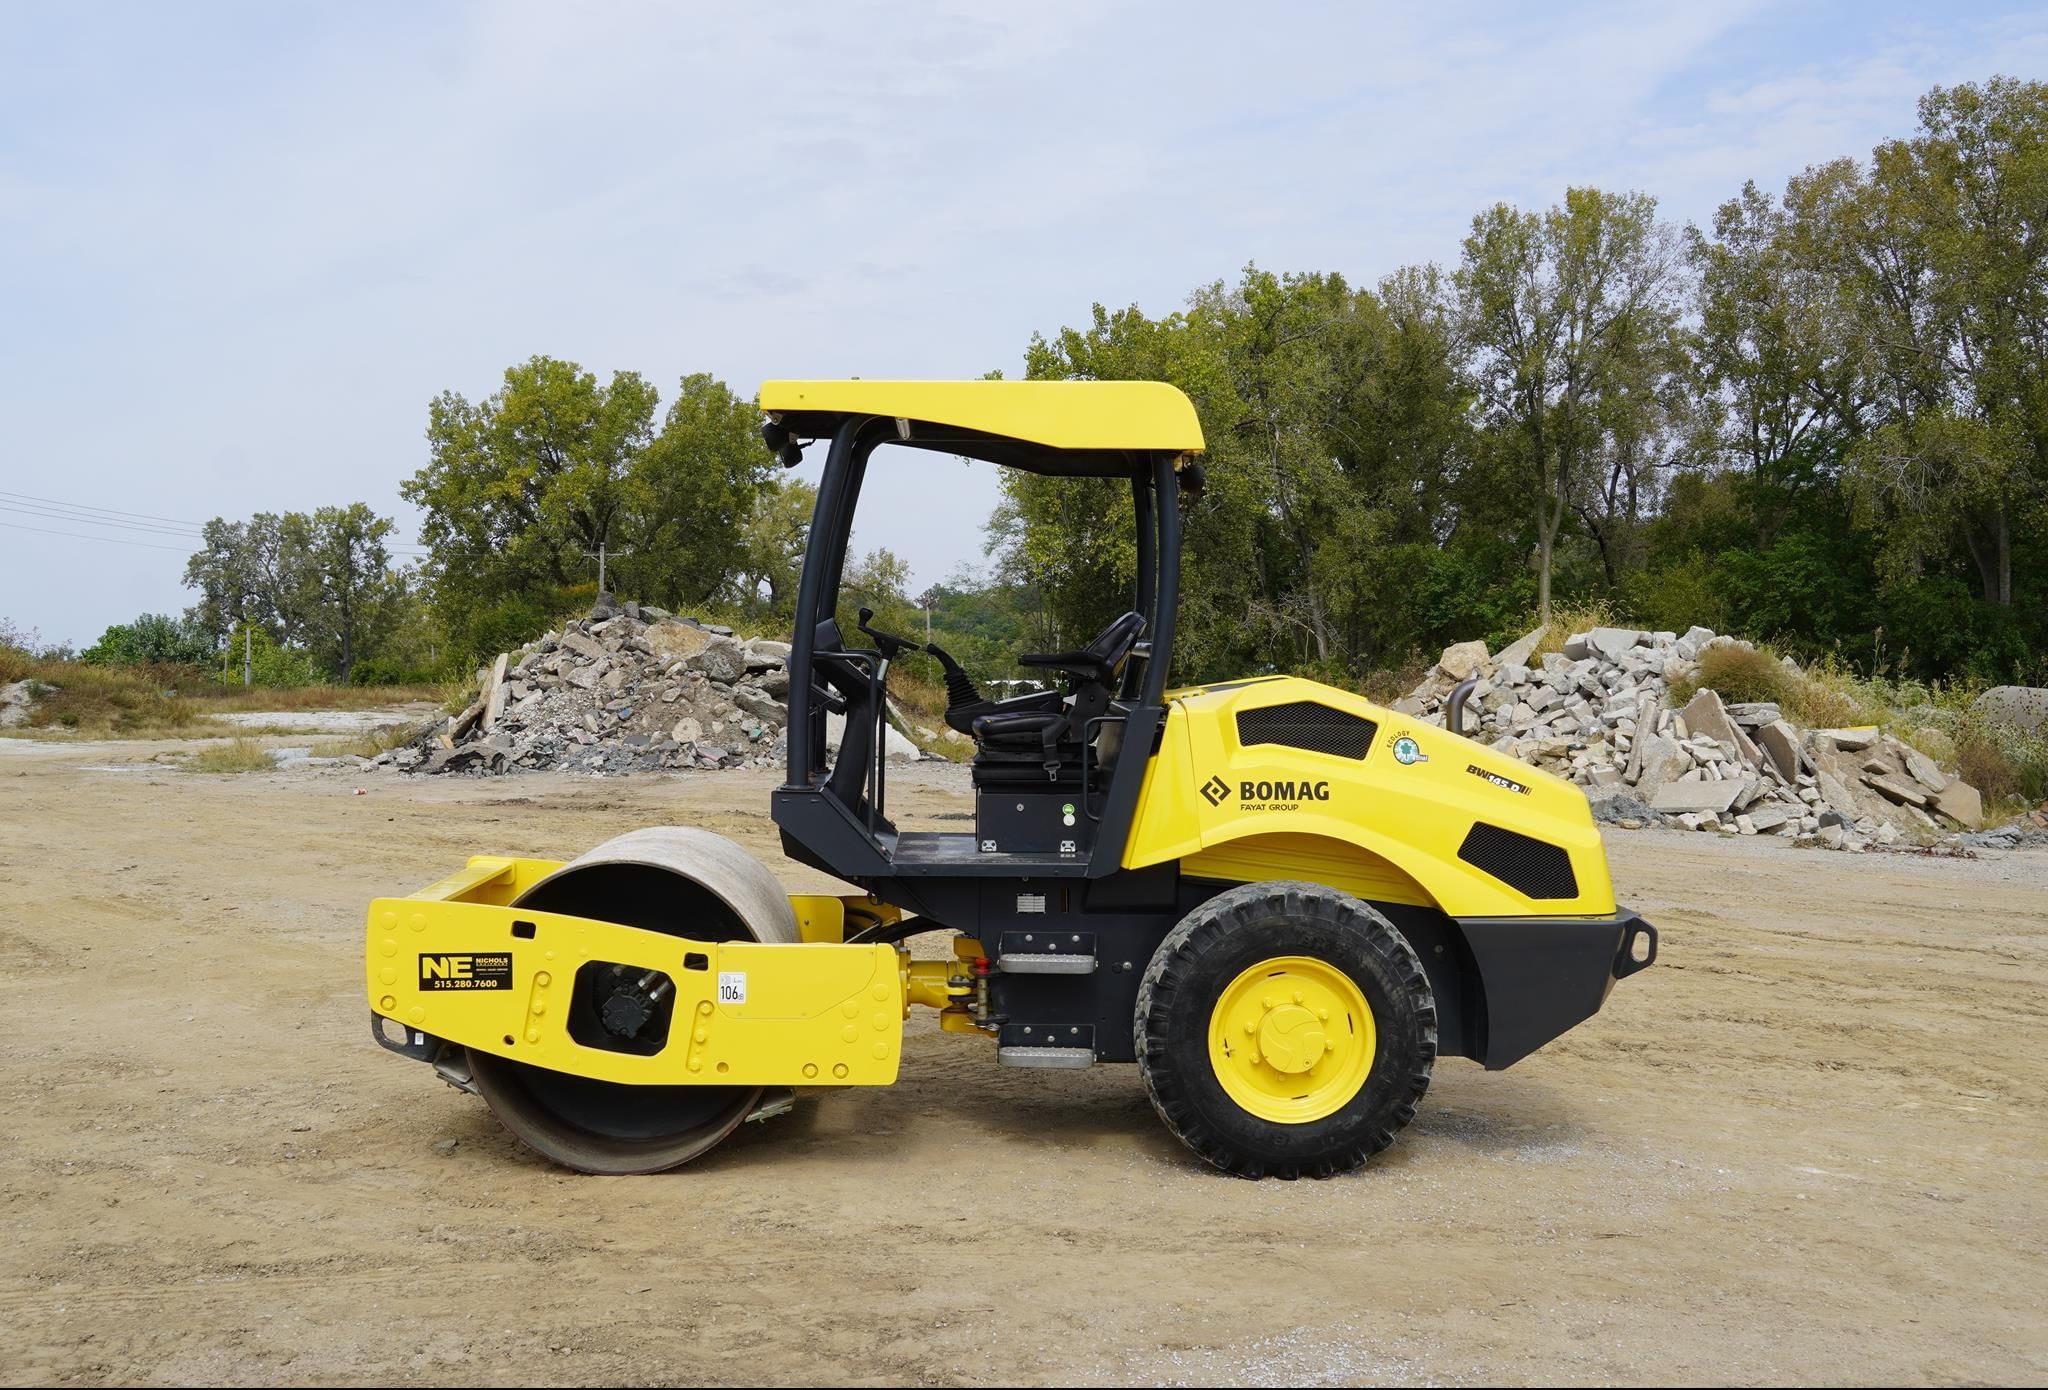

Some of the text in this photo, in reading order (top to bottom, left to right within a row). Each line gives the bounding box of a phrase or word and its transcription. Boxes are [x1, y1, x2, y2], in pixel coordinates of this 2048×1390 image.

[1386, 730, 1410, 748] ECOLOGY
[1240, 781, 1330, 801] BOMAG
[434, 979, 498, 988] 515.280.7600
[720, 985, 738, 1000] 106
